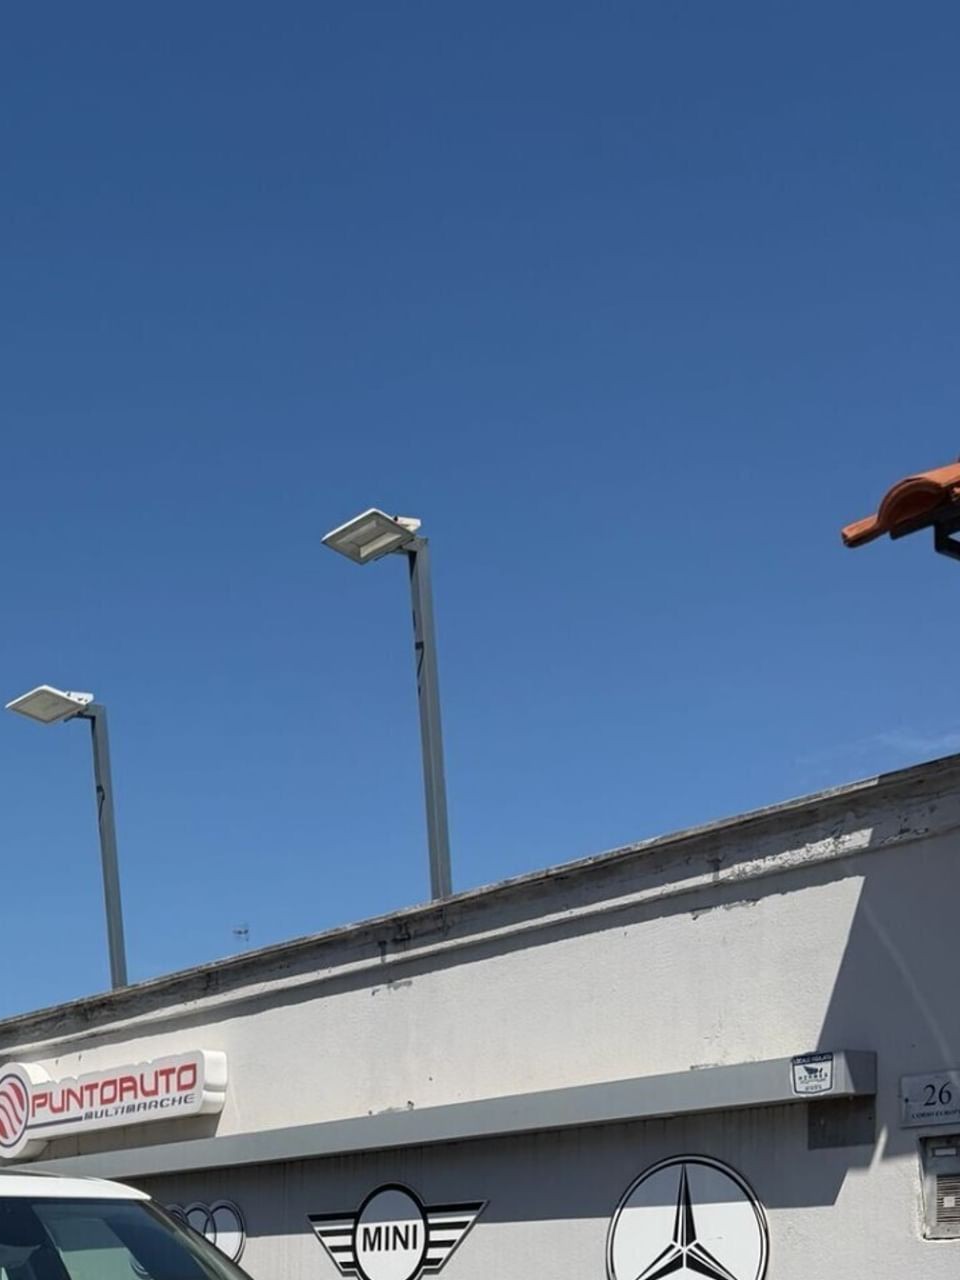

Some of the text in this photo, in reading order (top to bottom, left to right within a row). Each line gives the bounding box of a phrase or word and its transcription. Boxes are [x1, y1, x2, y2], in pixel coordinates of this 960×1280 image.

[32, 1063, 197, 1117] PUNTOAUTO
[923, 1081, 952, 1107] 26
[83, 1093, 195, 1121] MULTIMARCHE
[362, 1224, 418, 1252] MINI
